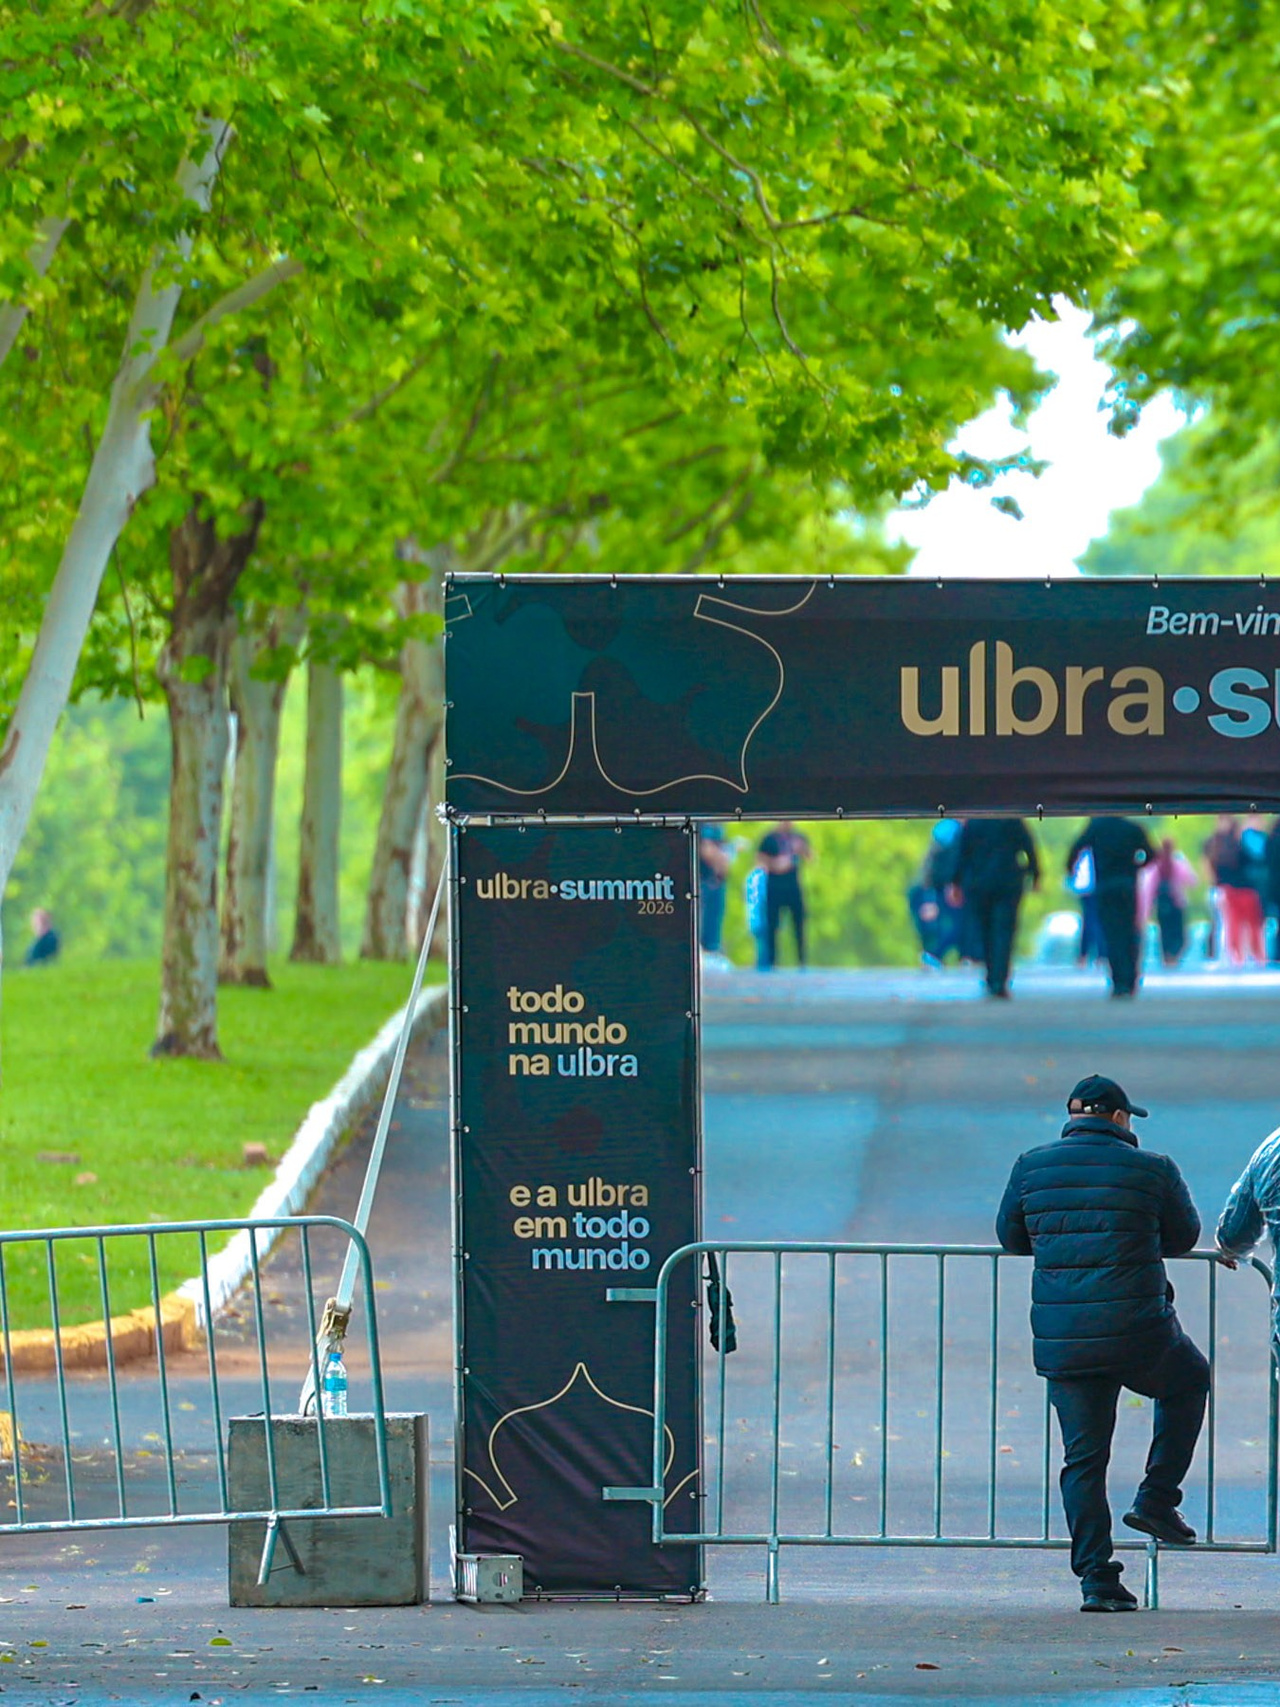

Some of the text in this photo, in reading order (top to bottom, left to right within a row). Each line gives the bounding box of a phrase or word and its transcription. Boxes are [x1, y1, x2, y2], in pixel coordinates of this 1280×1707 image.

[637, 900, 675, 915] 2026
[507, 984, 585, 1013] todo
[508, 1016, 628, 1045] mundo
[508, 1047, 638, 1077] na ulbra
[509, 1177, 648, 1207] e a ulbra
[513, 1210, 650, 1239] em todo
[532, 1241, 650, 1270] mundo
